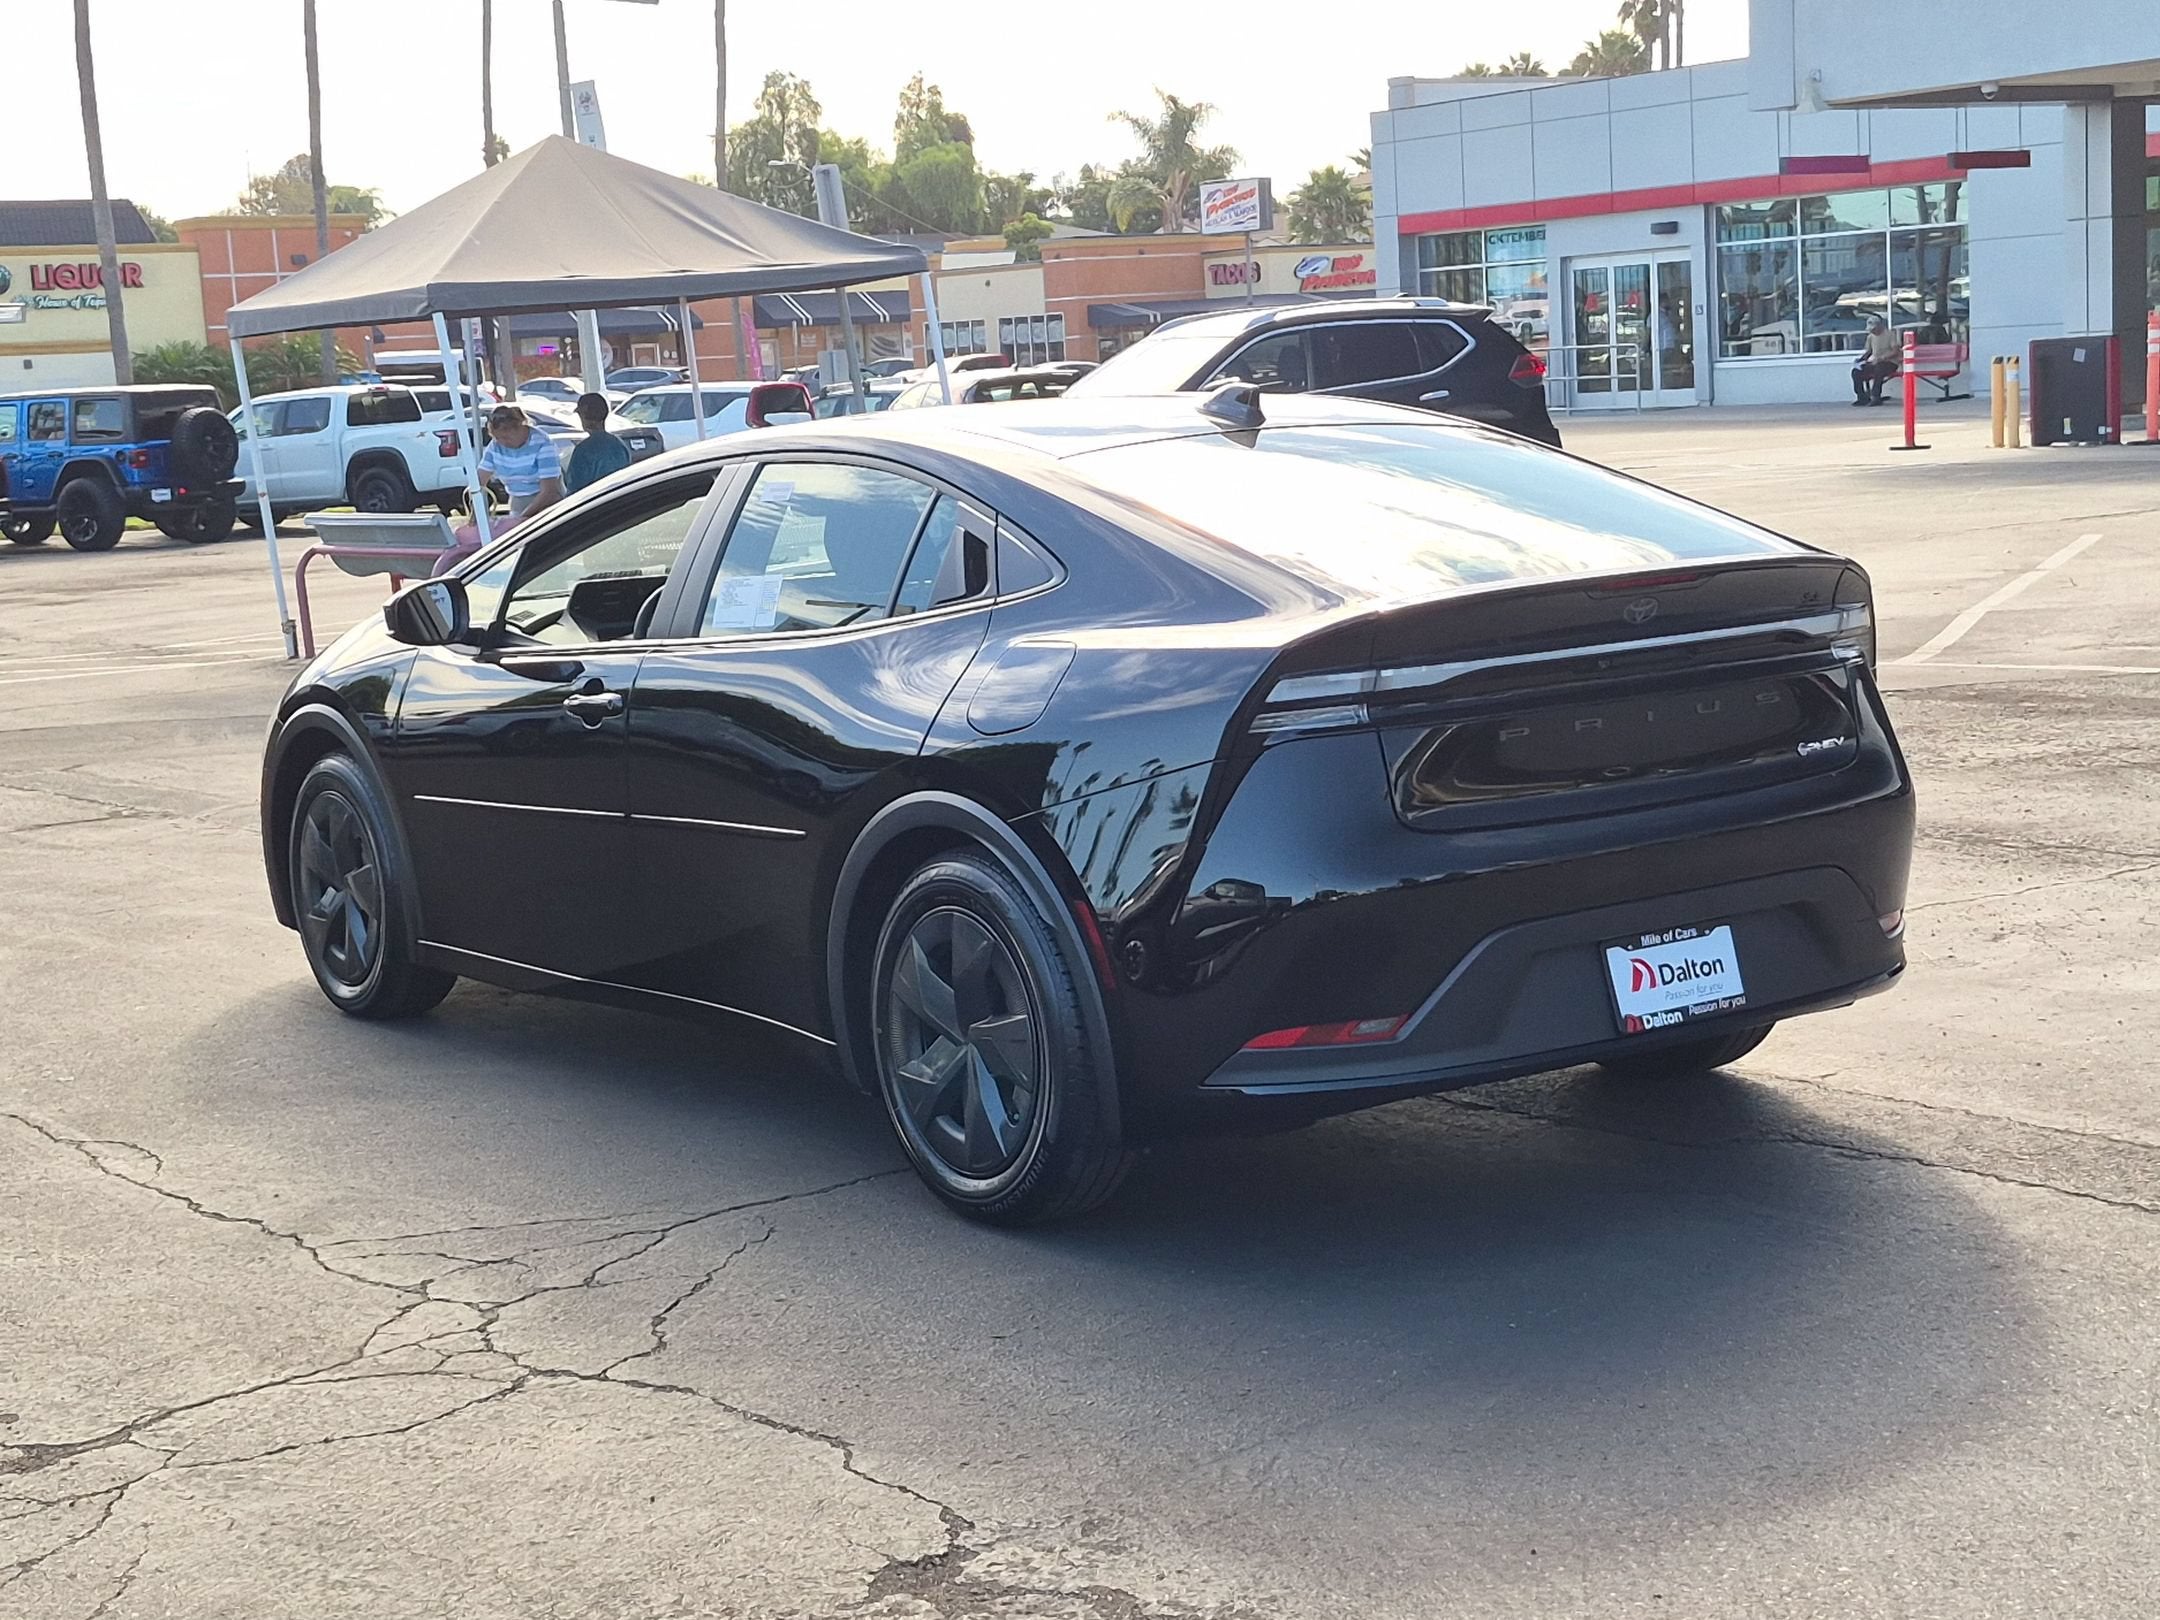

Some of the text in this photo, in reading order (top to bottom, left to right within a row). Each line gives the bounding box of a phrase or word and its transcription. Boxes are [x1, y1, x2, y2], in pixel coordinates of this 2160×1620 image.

[30, 262, 144, 291] LIQUR
[34, 294, 68, 310] House
[70, 294, 81, 311] of
[1500, 690, 1781, 741] PRIUS
[1640, 927, 1698, 947] Mile of Cars
[1657, 957, 1725, 986] Dalton
[1665, 983, 1724, 1001] Passion for you
[1642, 996, 1746, 1030] Dalton Passion for you
